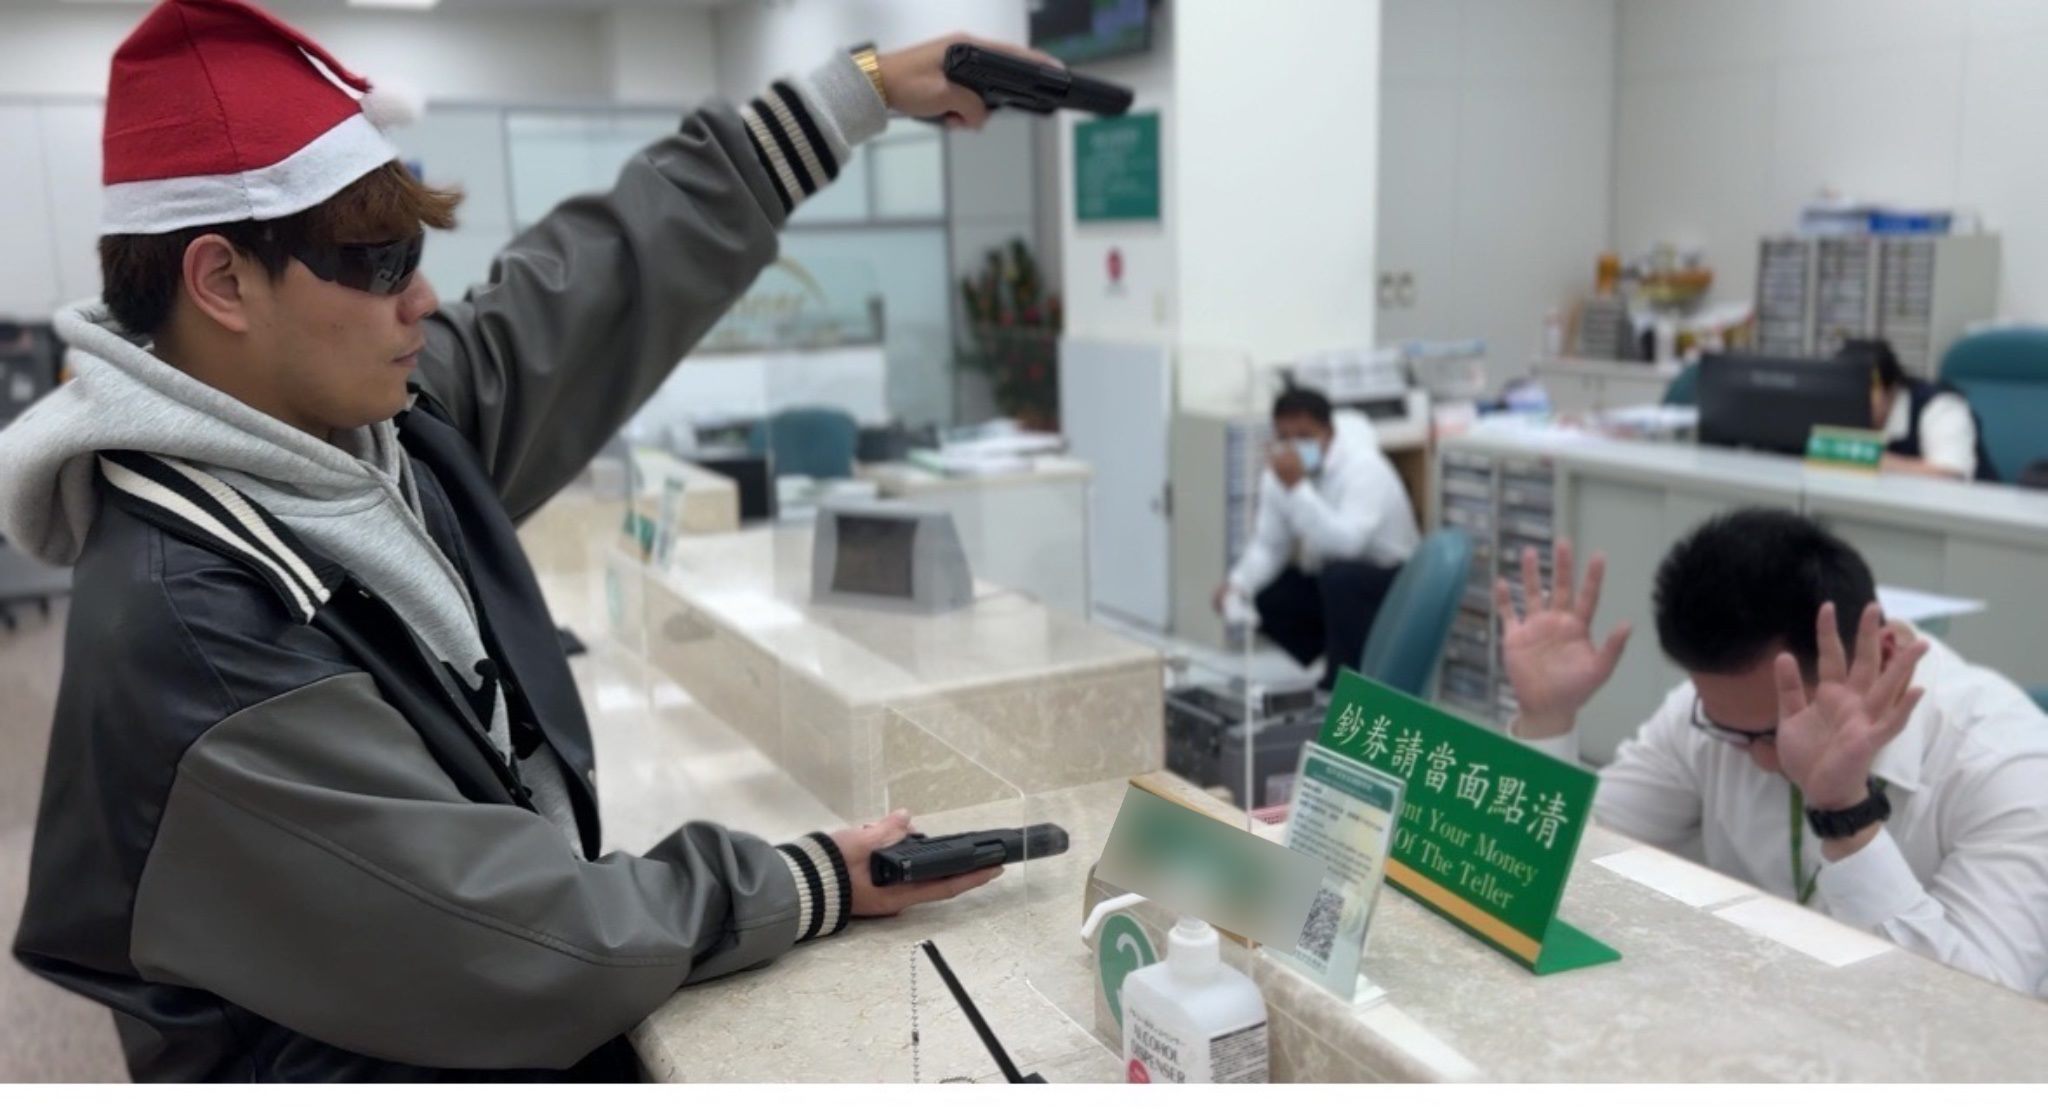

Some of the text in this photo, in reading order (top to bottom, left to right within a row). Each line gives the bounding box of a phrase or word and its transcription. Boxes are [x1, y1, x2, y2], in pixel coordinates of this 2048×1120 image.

[1333, 702, 1569, 849] 鈔券請當面點清
[1393, 827, 1515, 909] Of The Teller
[1430, 807, 1471, 848] Your
[1473, 832, 1539, 887] Money
